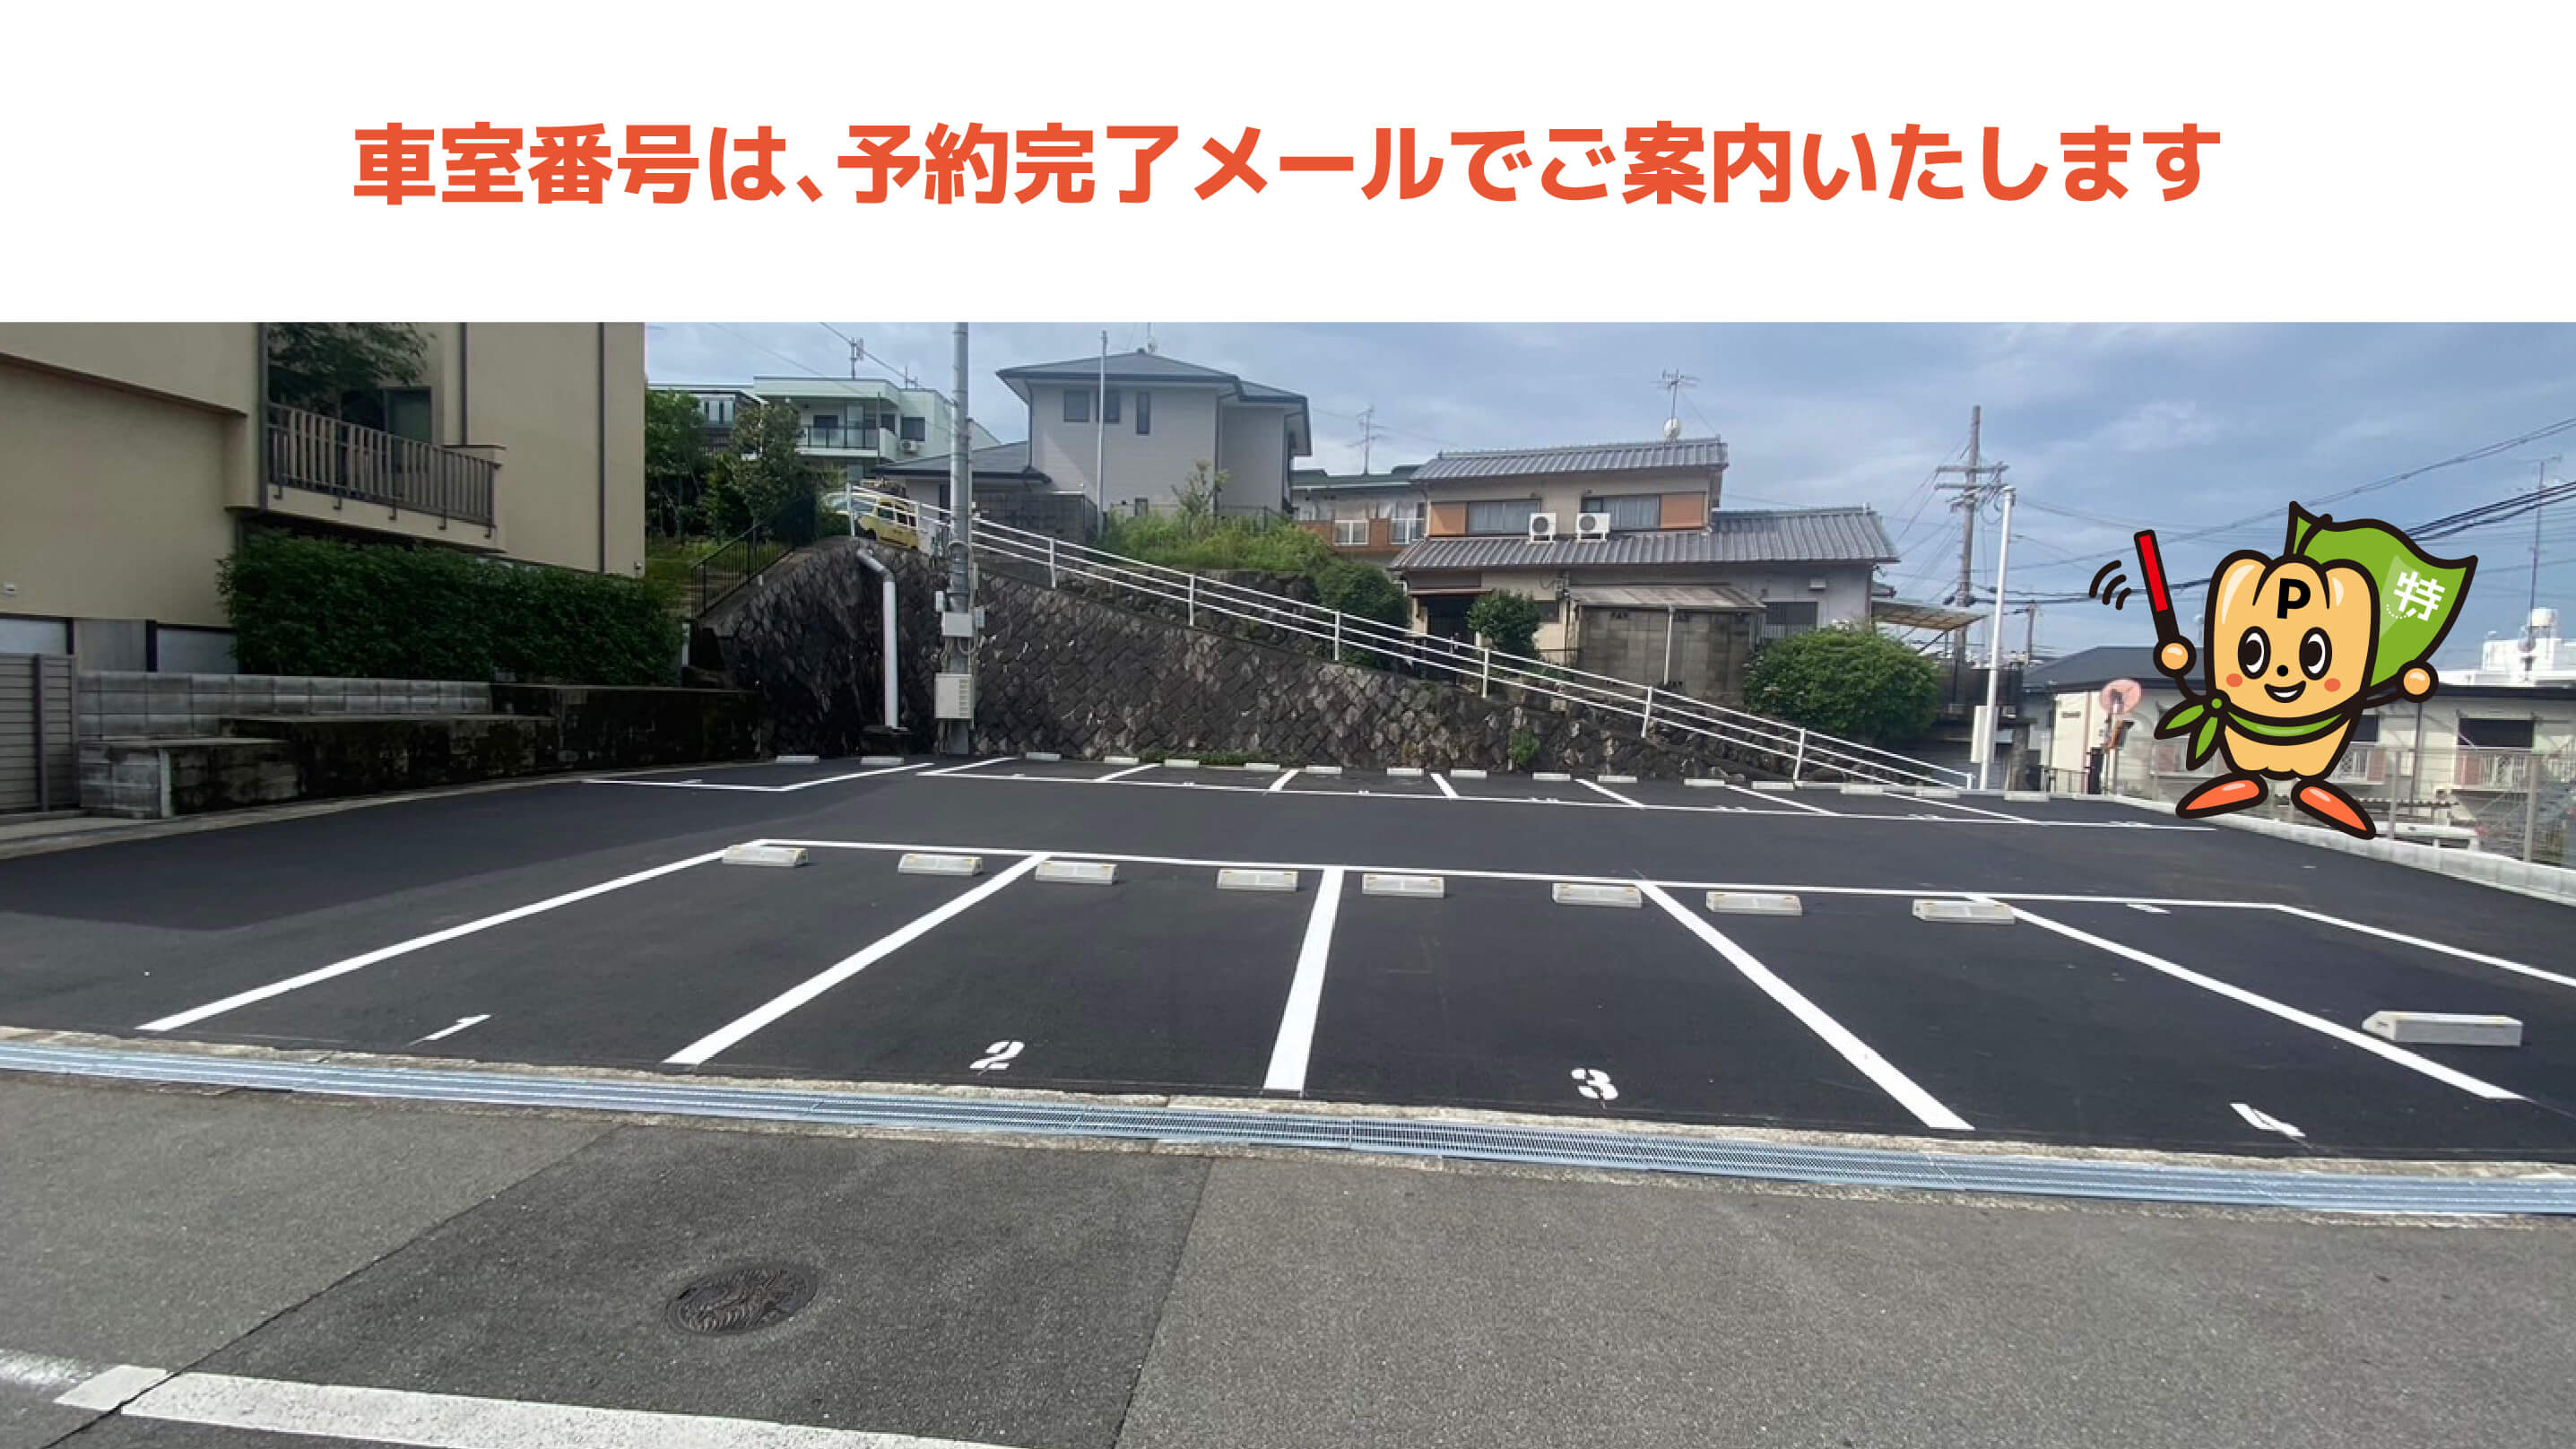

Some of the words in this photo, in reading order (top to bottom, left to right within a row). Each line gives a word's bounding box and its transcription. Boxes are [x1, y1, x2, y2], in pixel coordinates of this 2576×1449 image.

[969, 1040, 1025, 1070] 2
[1571, 1068, 1618, 1099] 3
[2230, 1103, 2306, 1137] 4
